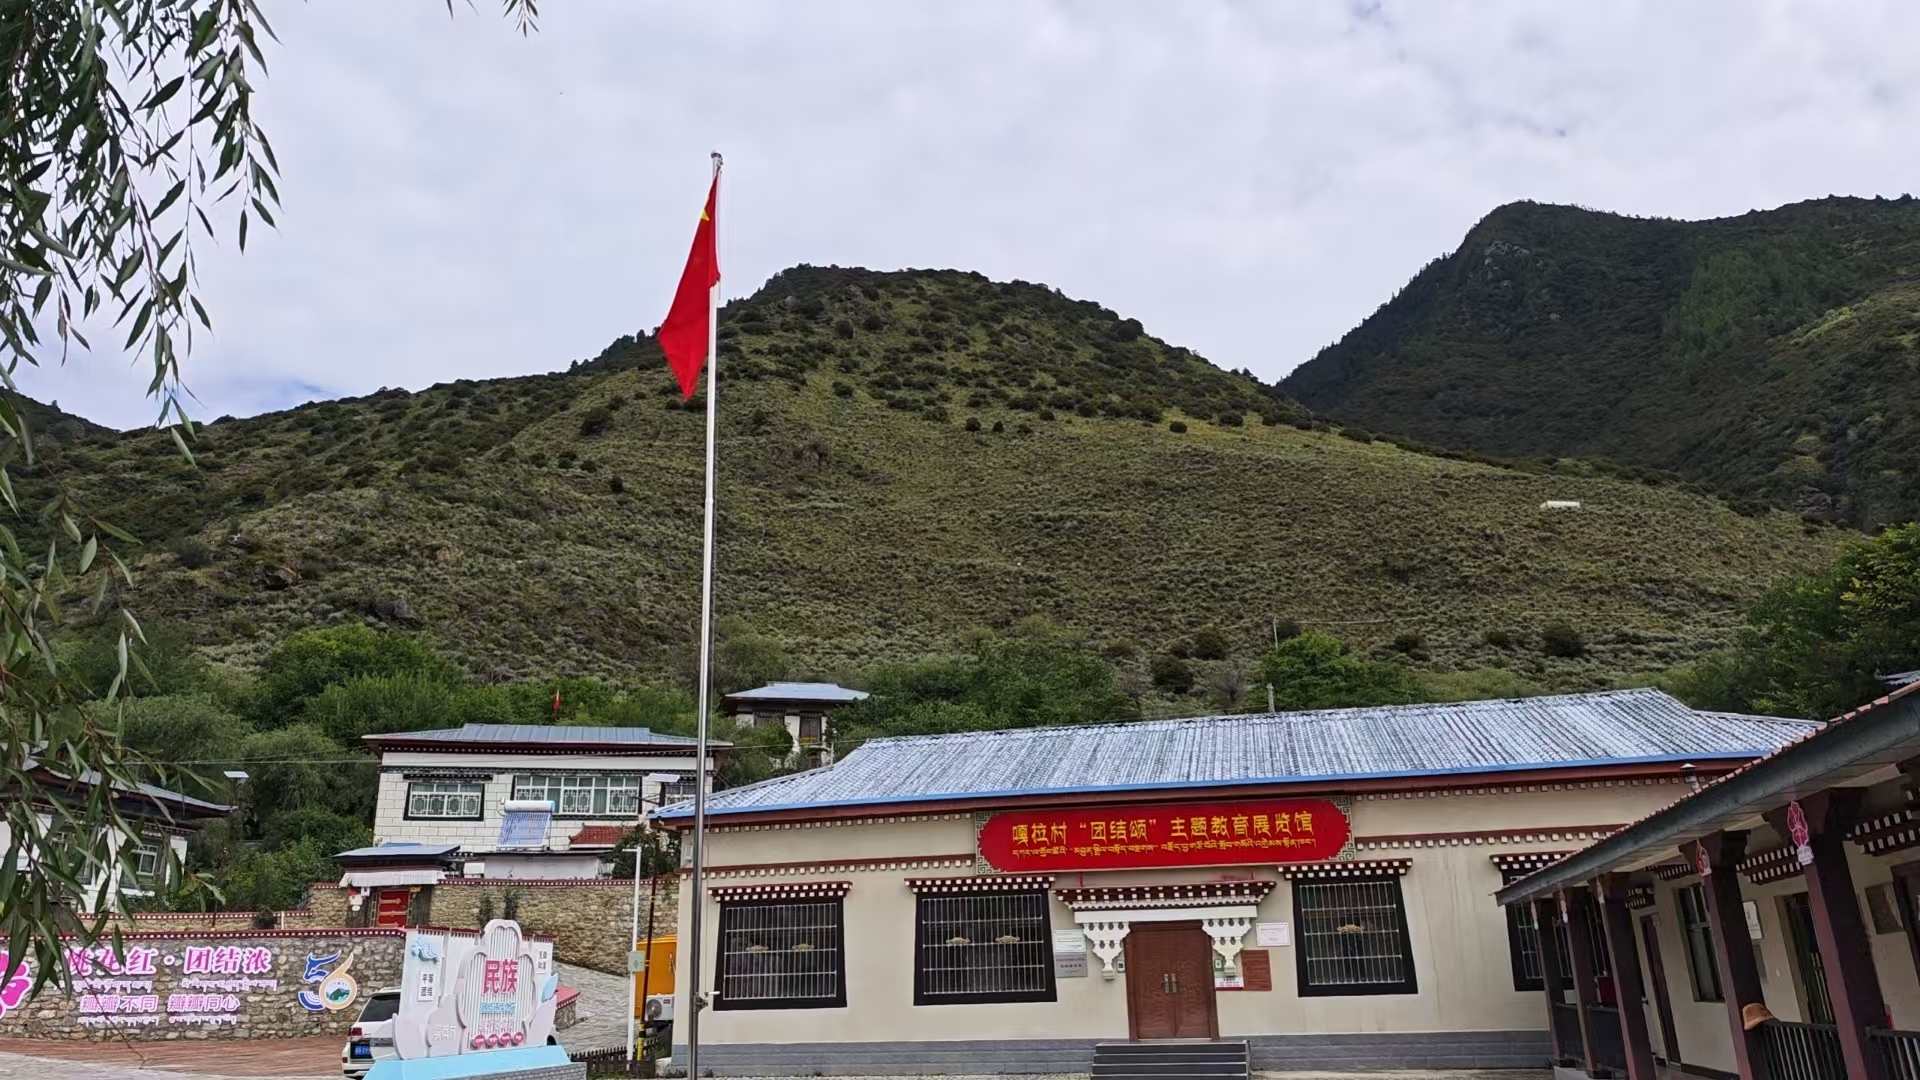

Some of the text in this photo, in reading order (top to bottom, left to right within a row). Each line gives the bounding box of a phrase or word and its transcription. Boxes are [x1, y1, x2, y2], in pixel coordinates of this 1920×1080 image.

[1012, 820, 1067, 847] 嘎拉村
[1170, 810, 1314, 840] 主题教育展览馆
[482, 958, 519, 994] 民族
[167, 993, 240, 1012] 瓣瓣同心
